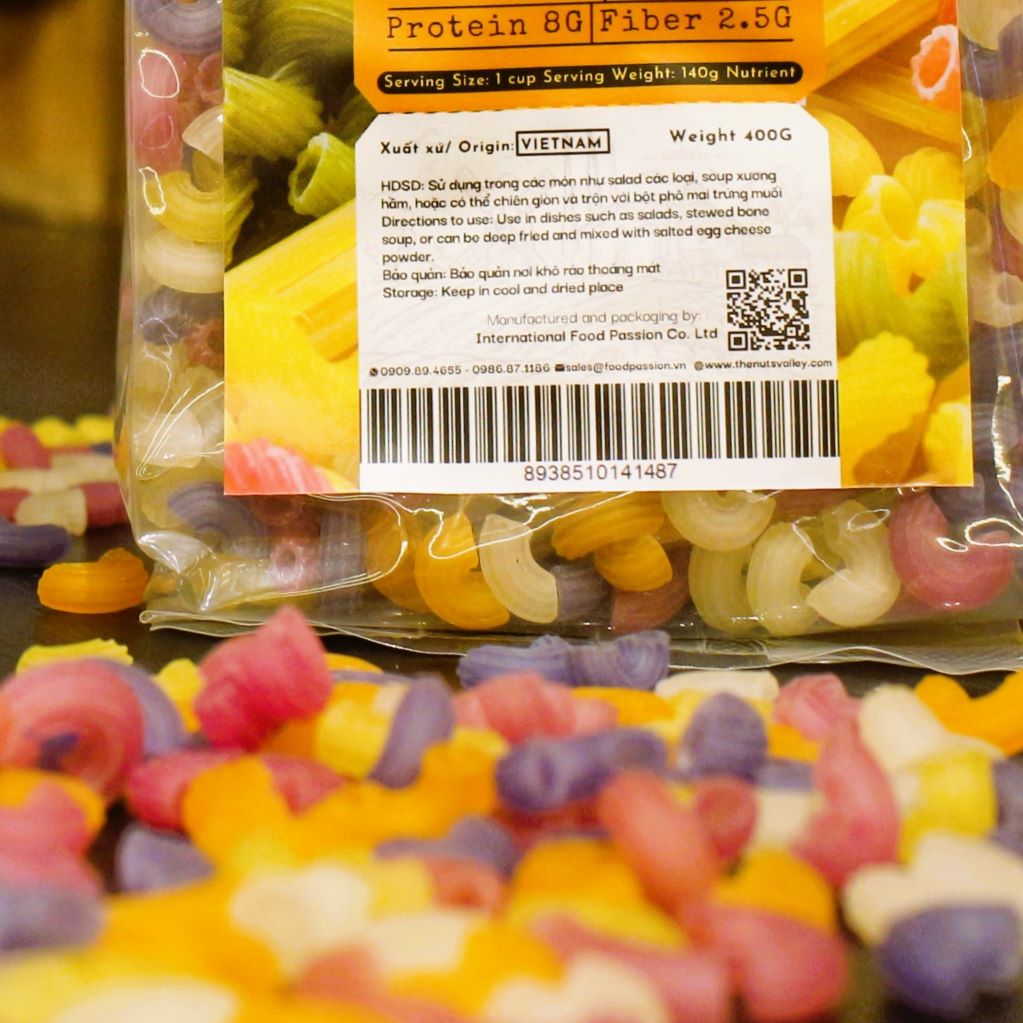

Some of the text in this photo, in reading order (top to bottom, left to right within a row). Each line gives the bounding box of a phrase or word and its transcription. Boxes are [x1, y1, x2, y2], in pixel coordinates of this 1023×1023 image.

[387, 10, 583, 38] Protein 8G
[600, 6, 791, 32] Fiber 2.5G
[384, 65, 796, 90] Serving Size: 1 cup Serving Weight: 140g Nutrient
[521, 136, 602, 151] VIETNAM
[669, 127, 792, 145] Weight 400G
[380, 141, 418, 154] Xuất
[458, 140, 514, 155] Origin:
[381, 180, 425, 192] HDSD:
[428, 178, 446, 191] Sử
[449, 179, 481, 193] dụng
[484, 179, 519, 192] trong
[522, 177, 546, 188] các
[580, 174, 605, 186] như
[608, 173, 642, 185] salad
[645, 172, 669, 184] các
[702, 172, 733, 184] soup
[450, 196, 466, 208] có
[493, 195, 529, 207] chiên
[687, 189, 709, 200] mai
[381, 206, 770, 227] Directions to use: Use in dishes such as salads, stewed bone
[382, 224, 772, 248] soup, or can be deep fried and mixed with salted egg cheese
[382, 251, 435, 265] powder.
[536, 265, 560, 276] khô
[383, 281, 624, 300] Storage: Keep in cool and dried place
[487, 312, 578, 326] Manufactured
[582, 311, 606, 323] and
[611, 310, 677, 324] packaging
[476, 327, 719, 344] International Food Passion Co. Ltd
[380, 366, 462, 376] 0909.89.4655
[566, 361, 687, 374] sales@foodpassion.vn
[705, 359, 833, 371] www.thenutsvalley.com
[524, 463, 677, 481] 8938510141487
